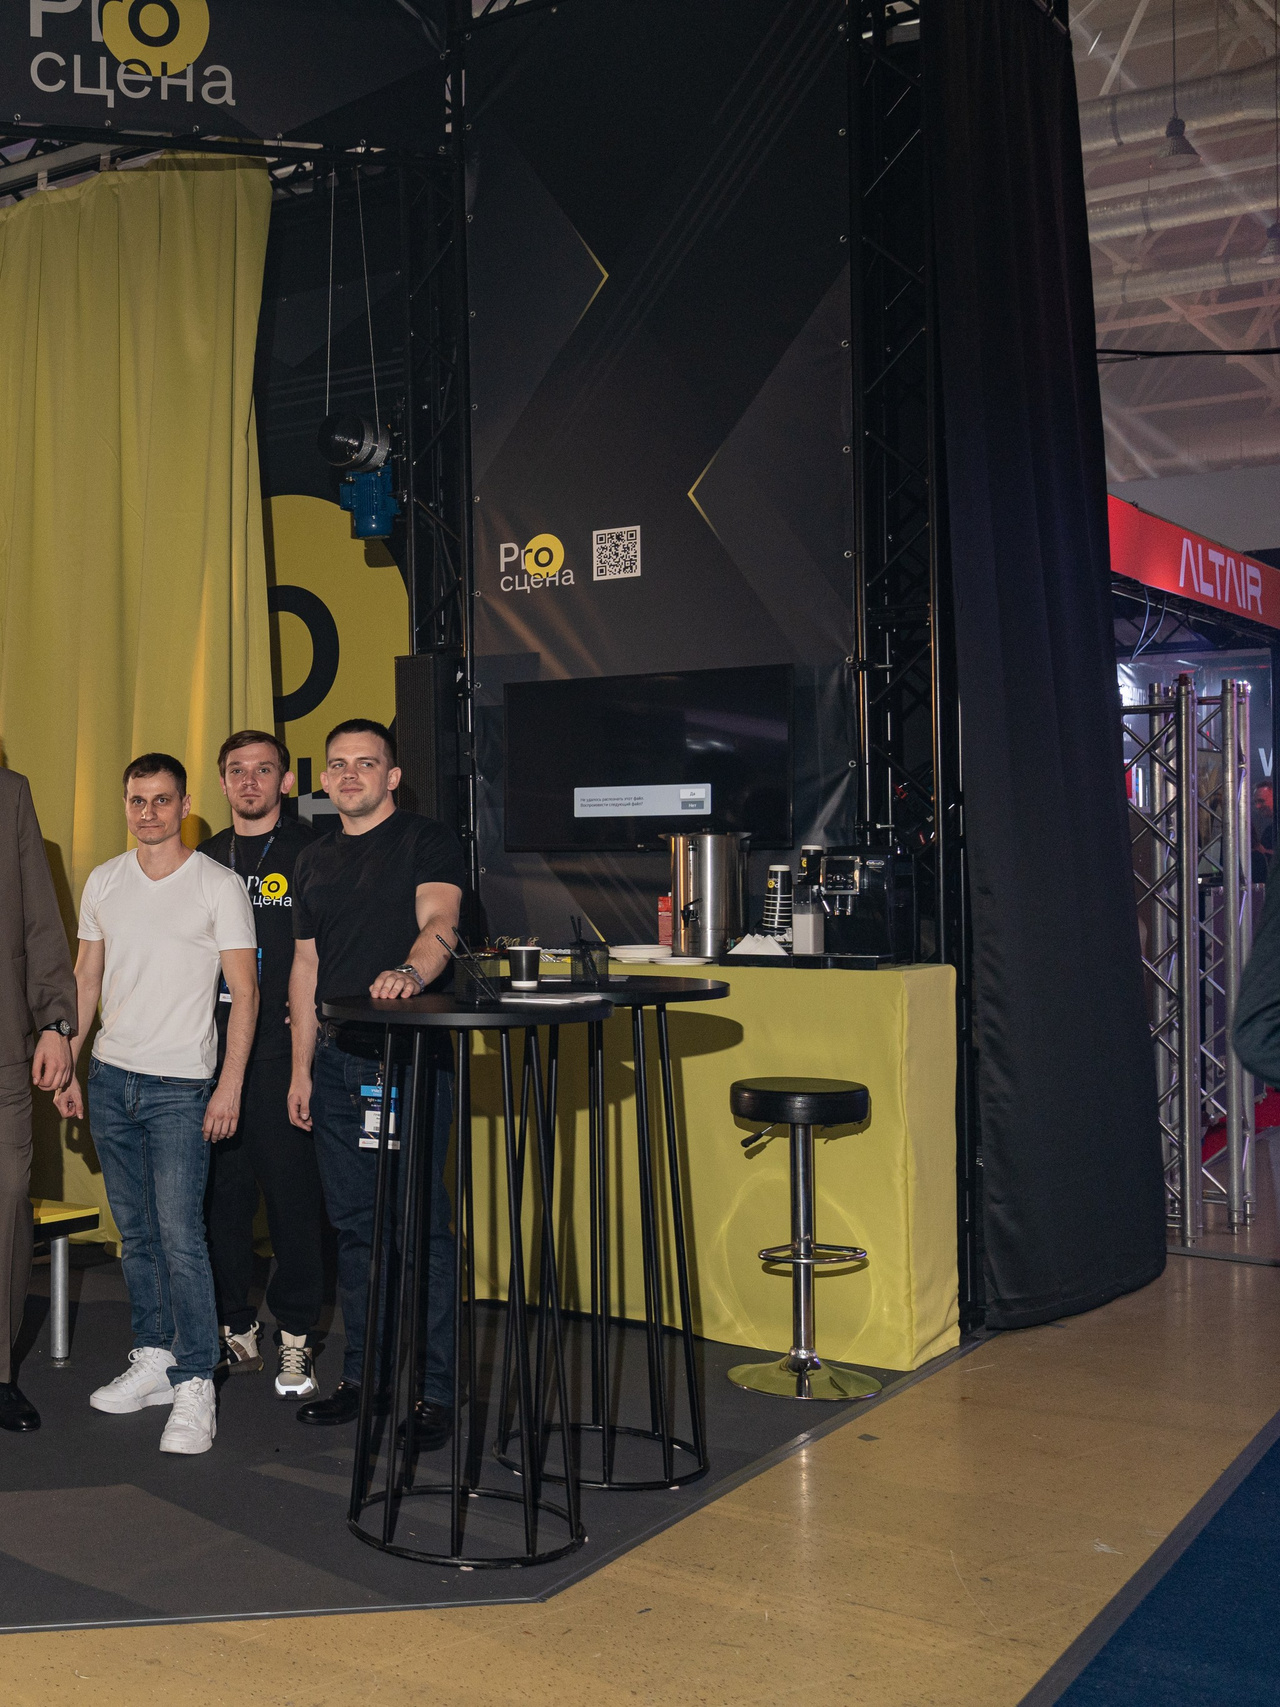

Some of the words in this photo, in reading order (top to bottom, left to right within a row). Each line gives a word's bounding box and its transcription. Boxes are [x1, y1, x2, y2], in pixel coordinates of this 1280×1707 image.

[30, 51, 236, 109] сцена
[499, 542, 554, 572] Pro
[500, 568, 575, 594] сцена
[1179, 537, 1263, 615] ALTAIR
[251, 895, 293, 908] цена
